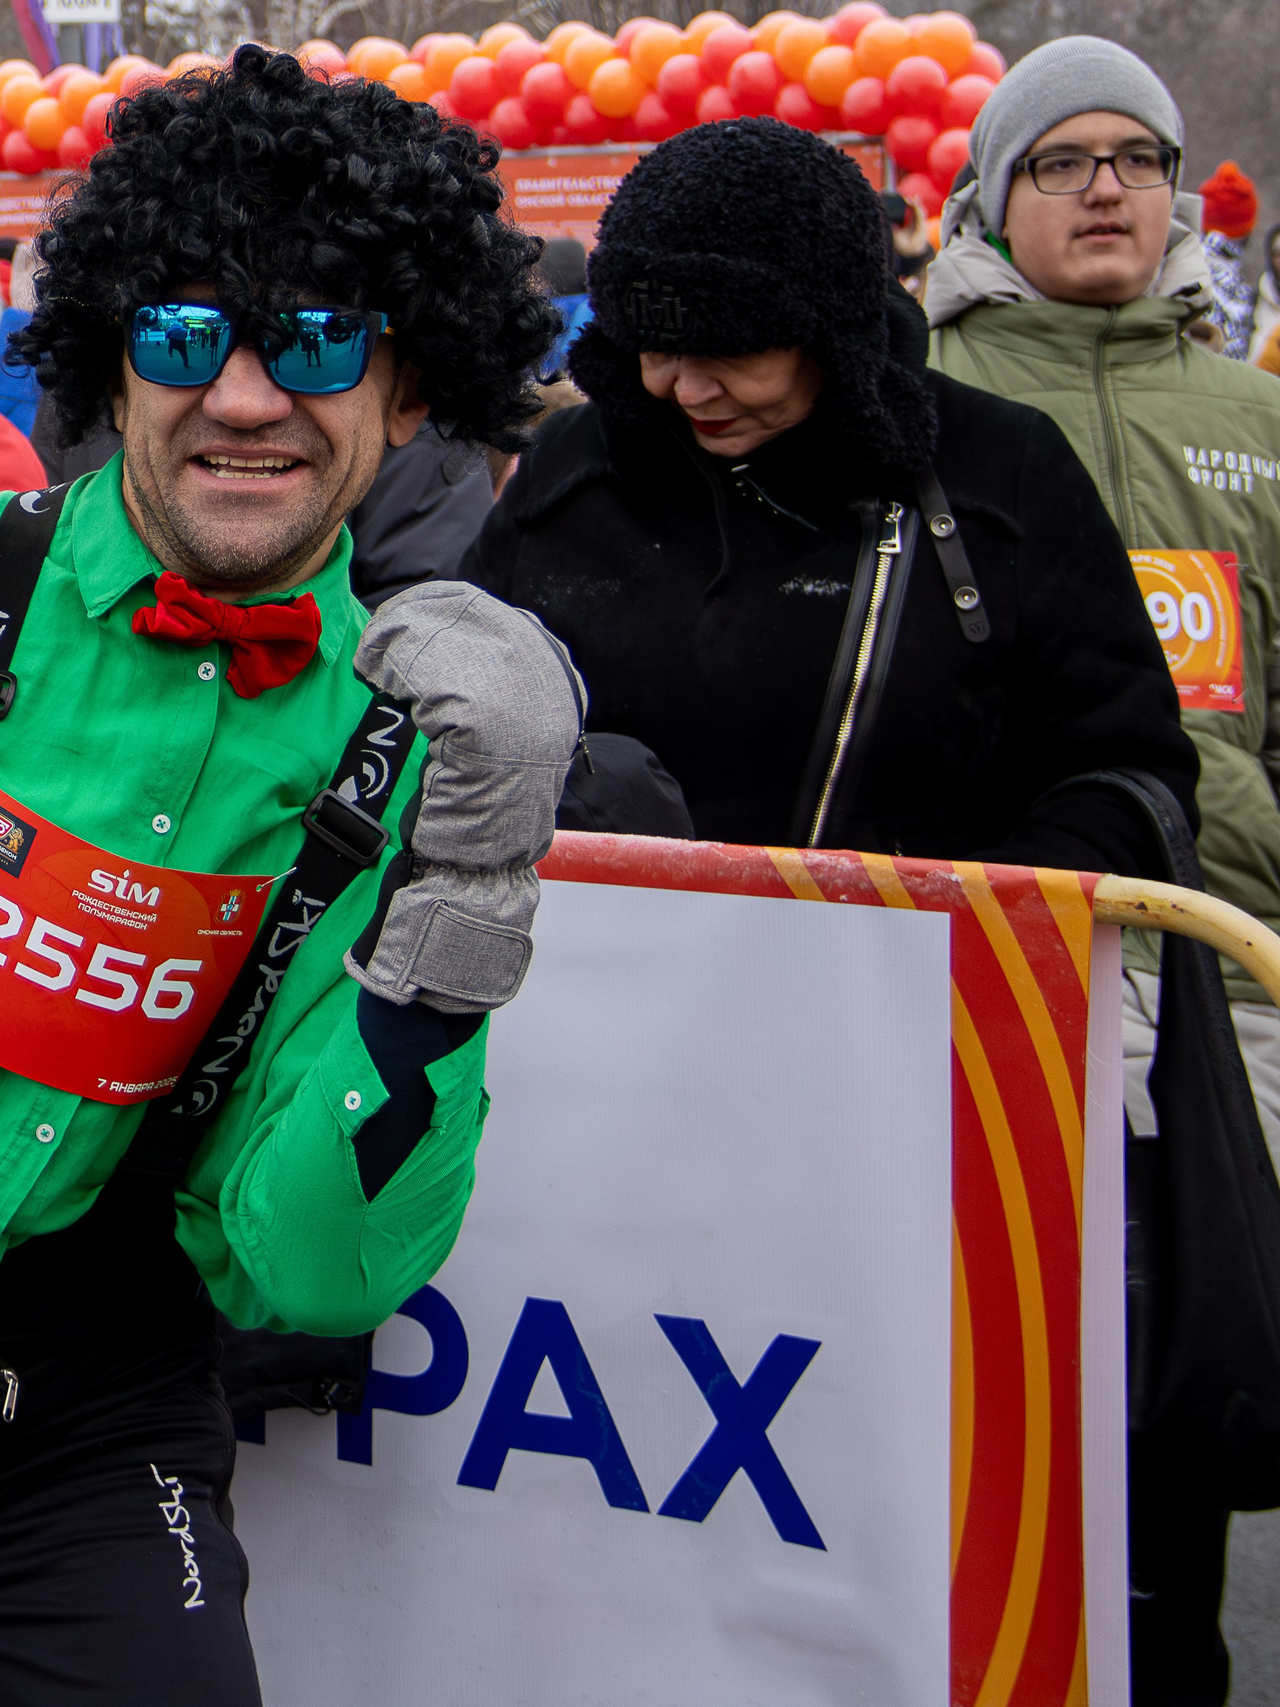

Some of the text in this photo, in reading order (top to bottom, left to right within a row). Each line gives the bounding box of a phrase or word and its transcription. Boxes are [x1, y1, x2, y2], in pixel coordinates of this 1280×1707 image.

[1187, 465, 1255, 494] ФРОНТ
[71, 889, 158, 923] РОЖДЕСТВЕНСКИЙ
[77, 902, 148, 930] ПОЛУМАРАФОН
[97, 1077, 107, 1089] 7
[109, 1081, 155, 1093] ЯНВАРЯ
